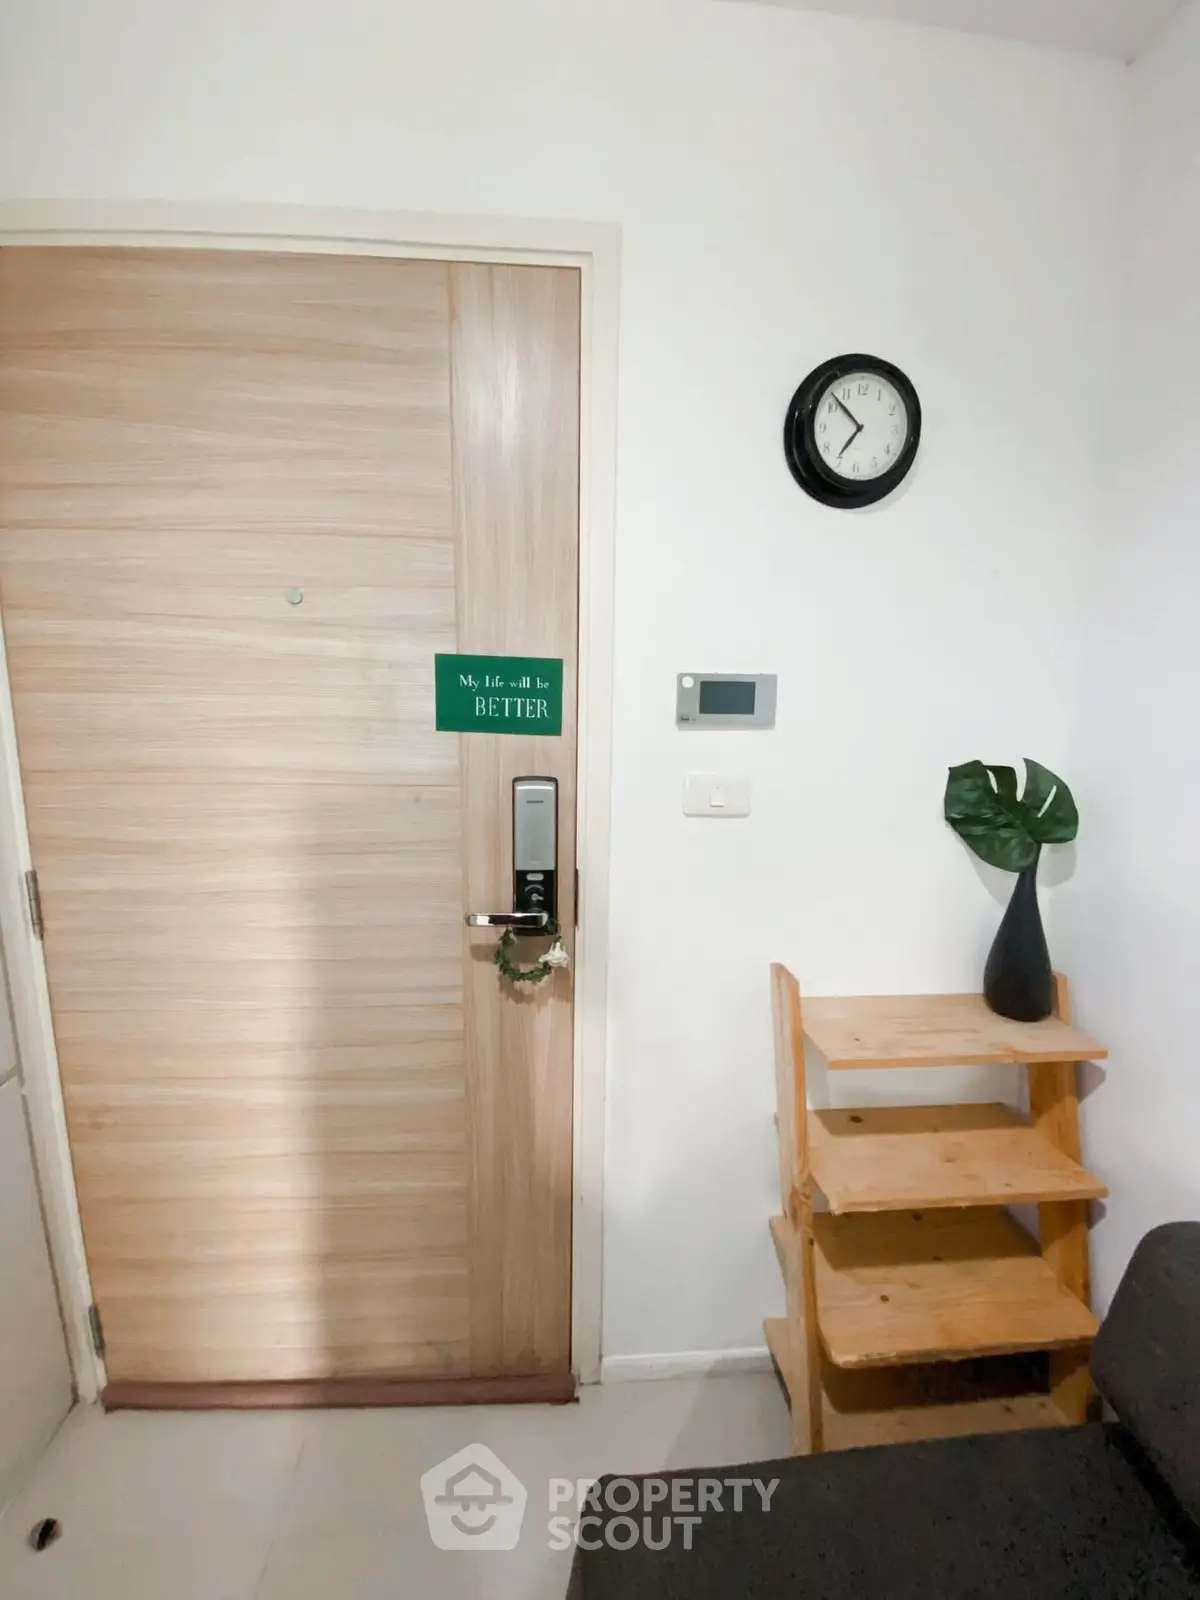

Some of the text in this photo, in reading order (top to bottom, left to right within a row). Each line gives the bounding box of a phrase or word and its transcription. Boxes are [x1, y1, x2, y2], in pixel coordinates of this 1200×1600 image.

[842, 387, 851, 401] 11
[857, 383, 869, 396] 12
[877, 388, 882, 402] 1
[827, 401, 838, 414] 10
[888, 403, 896, 416] 2
[819, 423, 827, 434] 9
[891, 424, 899, 435] 3
[823, 442, 831, 454] 8
[884, 443, 891, 456] 4
[837, 455, 843, 469] 7
[871, 456, 878, 469] 5
[459, 674, 550, 692] My life will be
[475, 696, 551, 719] BETTER
